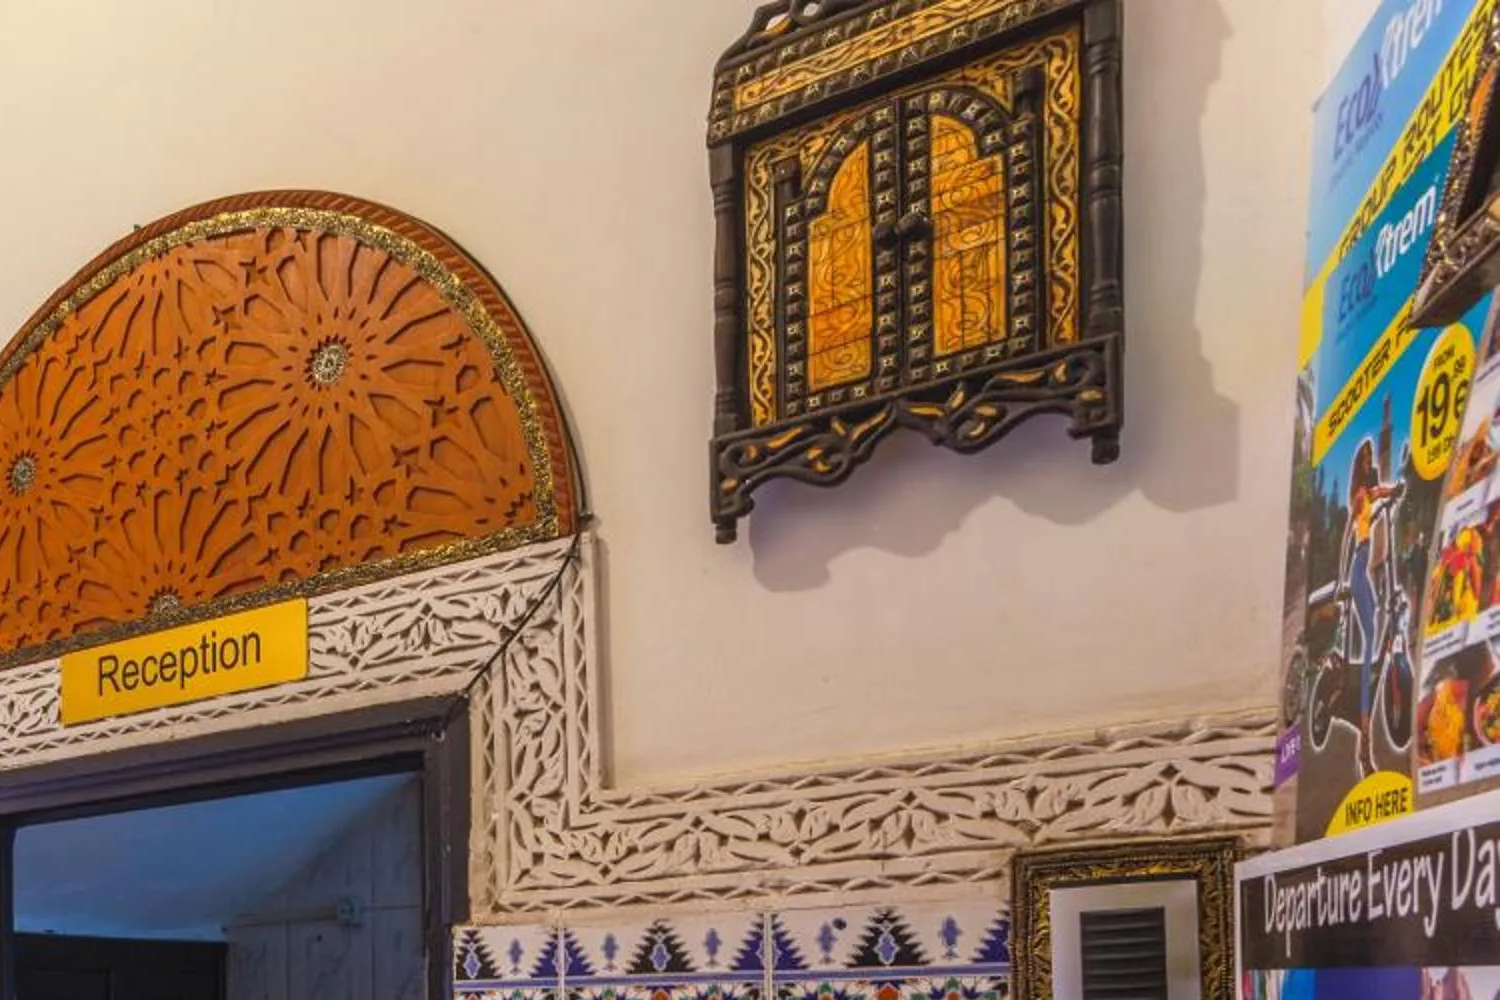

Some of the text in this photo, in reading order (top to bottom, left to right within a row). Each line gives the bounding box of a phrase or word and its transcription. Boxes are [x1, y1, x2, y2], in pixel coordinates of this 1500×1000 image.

[98, 630, 261, 697] Reception
[1345, 787, 1408, 829] INFO HERE
[1264, 827, 1500, 957] Departure Every Da
